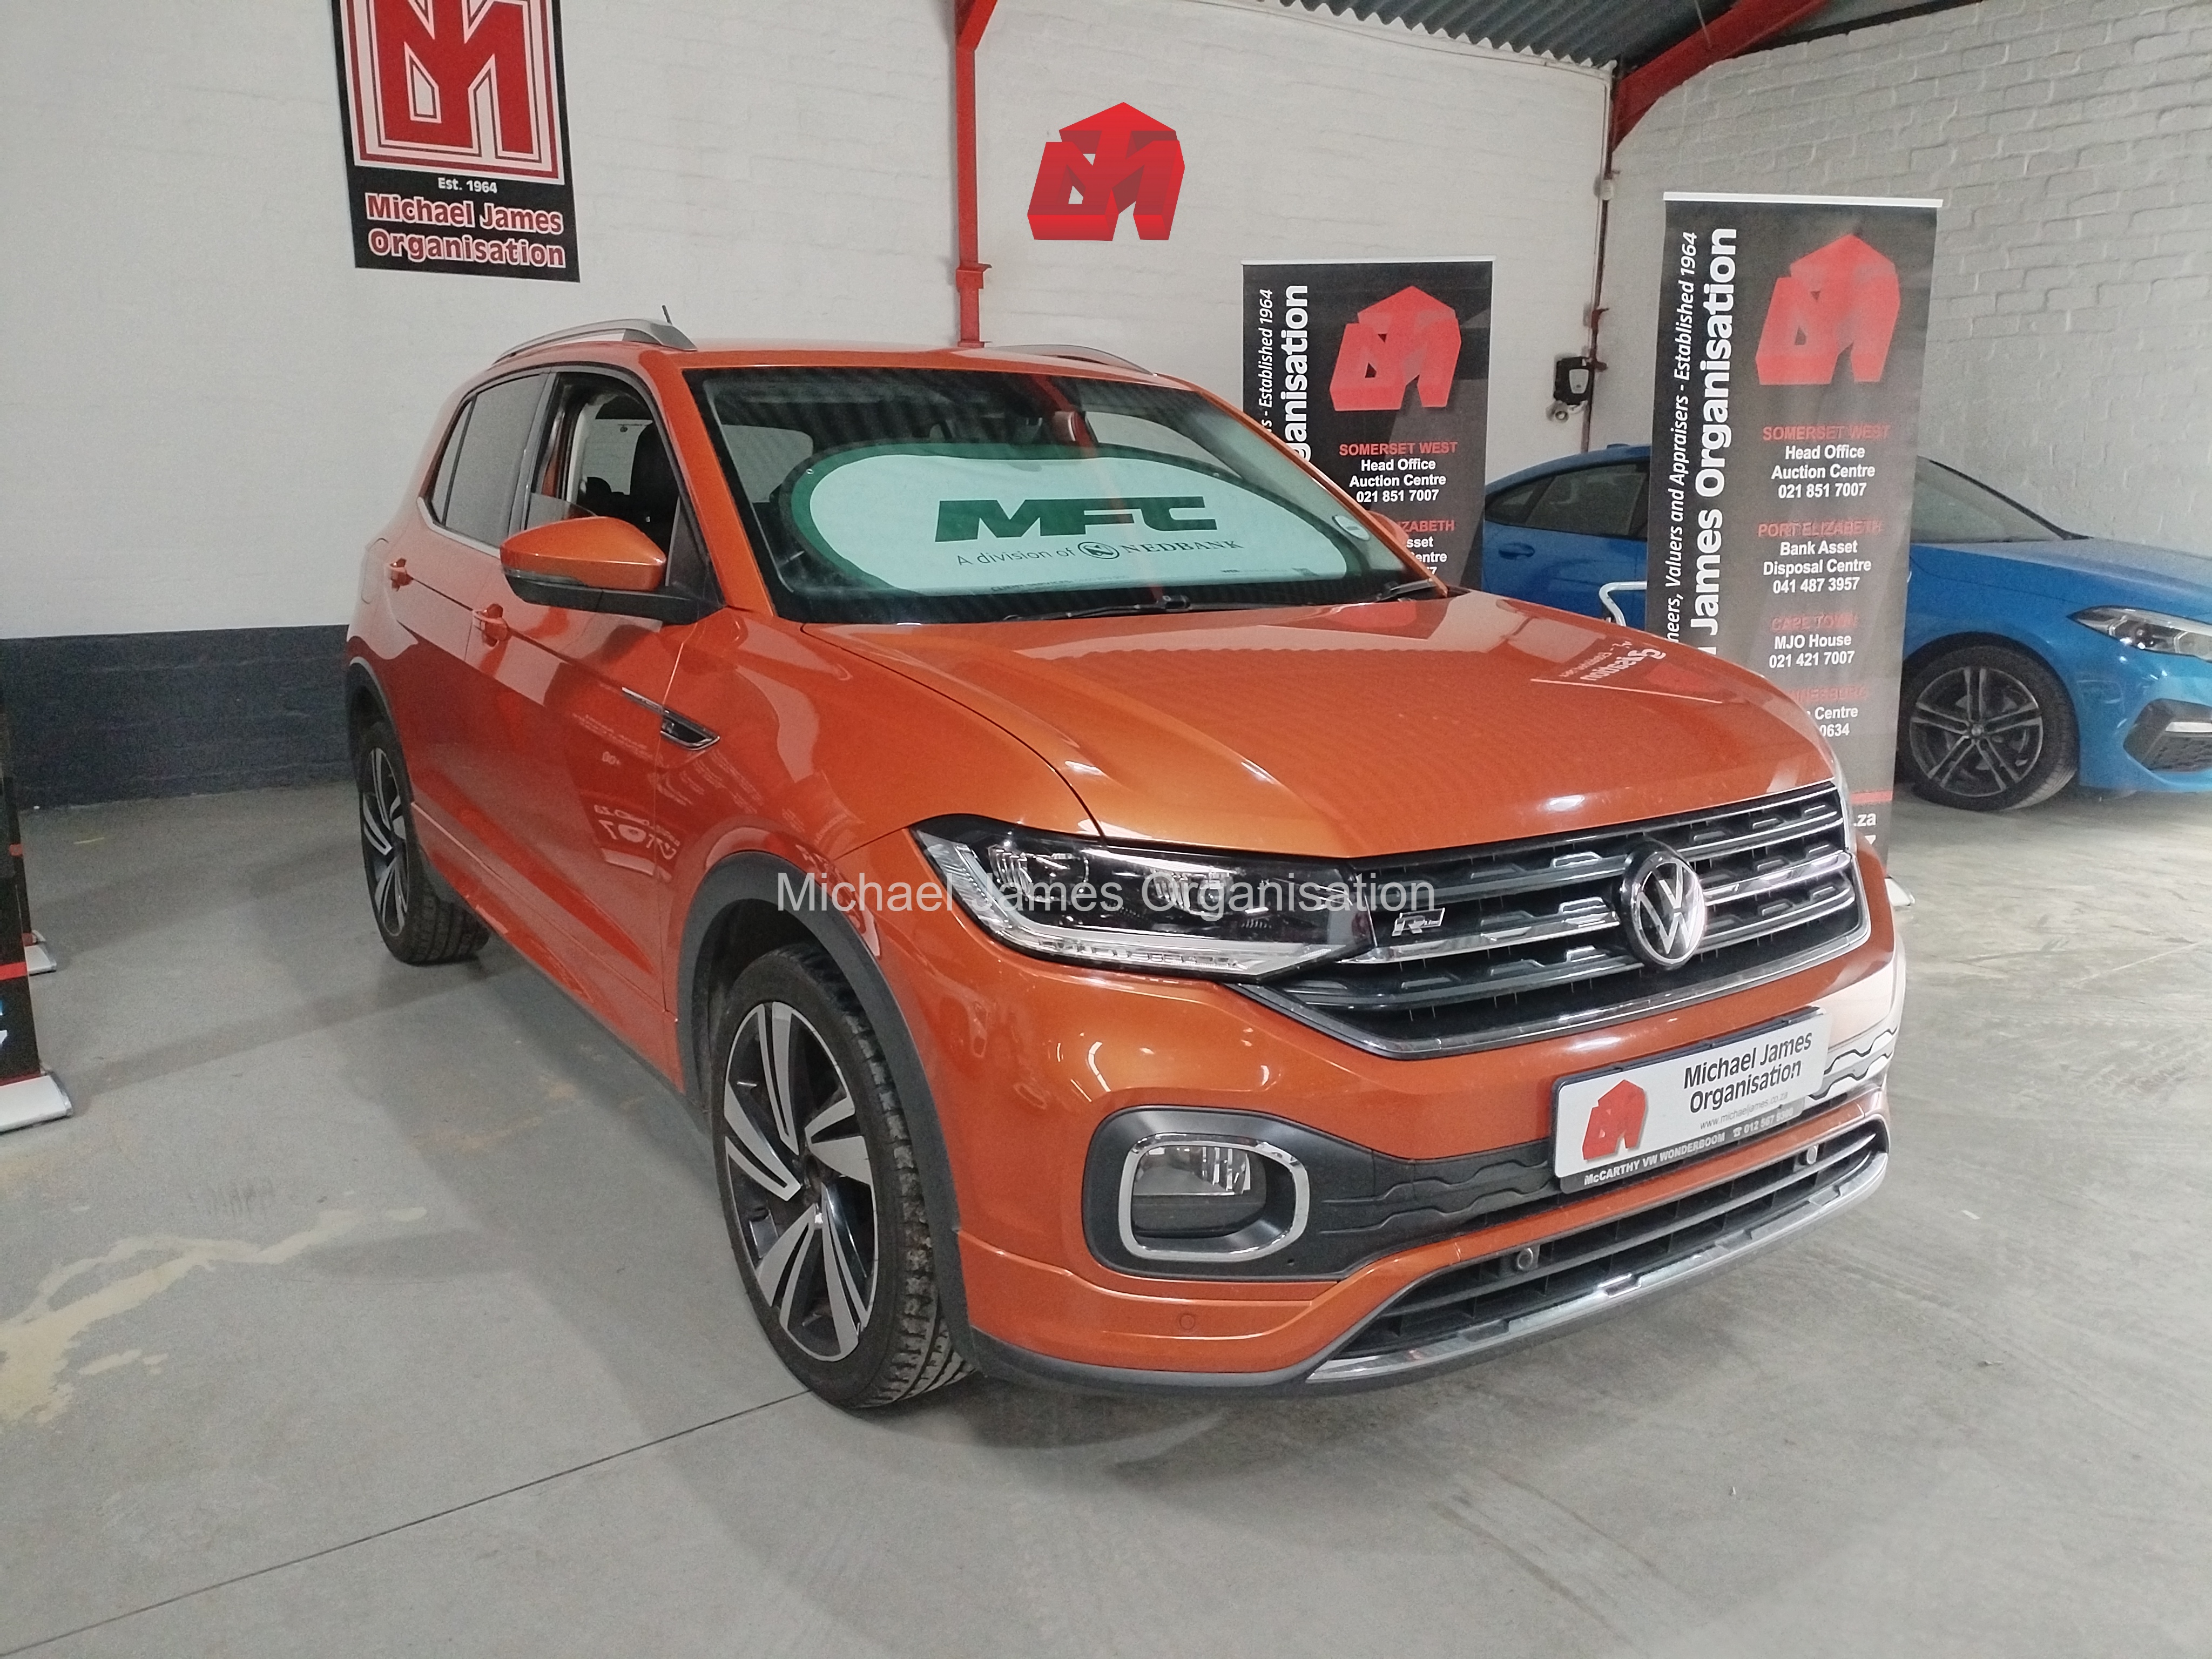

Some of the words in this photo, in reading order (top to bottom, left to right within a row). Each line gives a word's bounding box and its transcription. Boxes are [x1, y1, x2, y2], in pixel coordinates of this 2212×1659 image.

[438, 177, 463, 191] Est.
[466, 179, 498, 194] 1964
[365, 192, 476, 228] Michael
[480, 202, 564, 234] James
[368, 227, 567, 268] Organisation
[1681, 232, 1697, 276] 1964
[1258, 288, 1273, 325] 1964
[1674, 280, 1694, 380] Established
[1258, 327, 1273, 408] Established
[1695, 228, 1737, 497] Organisation
[1669, 395, 1689, 486] Appraisers
[1763, 426, 1843, 441] SOMERSET
[1849, 424, 1890, 440] WEST
[1339, 442, 1415, 456] SOMERSET
[1419, 441, 1458, 455] WEST
[1785, 445, 1820, 460] Head
[1824, 444, 1865, 458] Office
[1361, 458, 1395, 472] Head
[1398, 458, 1436, 471] Office
[1771, 465, 1826, 480] Auction
[1830, 463, 1876, 478] Centre
[1350, 474, 1400, 488] Auction
[1404, 474, 1447, 486] Centre
[1778, 484, 1802, 498] 021
[1805, 483, 1830, 497] 851
[1835, 482, 1867, 496] 7007
[1356, 489, 1379, 503] 021
[1382, 489, 1405, 502] 851
[1408, 488, 1440, 502] 7007
[1668, 488, 1684, 522] and
[935, 496, 1218, 543] MFC
[1758, 522, 1796, 537] PORT
[1802, 519, 1881, 537] ELIZABETH
[957, 554, 974, 567] A
[977, 548, 1051, 564] division
[1055, 546, 1076, 559] of
[1122, 540, 1244, 554] NEDBANK
[1411, 551, 1447, 563] entre
[1665, 525, 1683, 587] Valuers
[1780, 541, 1816, 556] Bank
[1818, 540, 1858, 555] Asset
[1690, 509, 1723, 636] James
[1763, 559, 1823, 577] Disposal
[1826, 558, 1872, 572] Centre
[1773, 579, 1796, 594] 041
[1800, 578, 1825, 592] 487
[1828, 577, 1860, 591] 3957
[1775, 635, 1805, 650] MJO
[1809, 633, 1852, 648] House
[1769, 653, 1791, 668] 021
[1796, 652, 1819, 666] 421
[1824, 650, 1855, 665] 7007
[1815, 706, 1858, 720] Centre
[1819, 723, 1850, 737] 0634
[1683, 1048, 1757, 1089] Michael
[1760, 1032, 1813, 1063] James
[1690, 1060, 1802, 1114] Organisation
[1700, 1091, 1789, 1130] www.michaeljames.co.za
[1584, 1159, 1641, 1185] McCARTHY
[1642, 1155, 1658, 1168] VW
[1660, 1132, 1726, 1161] WONDERBOOM
[1744, 1120, 1759, 1134] 012
